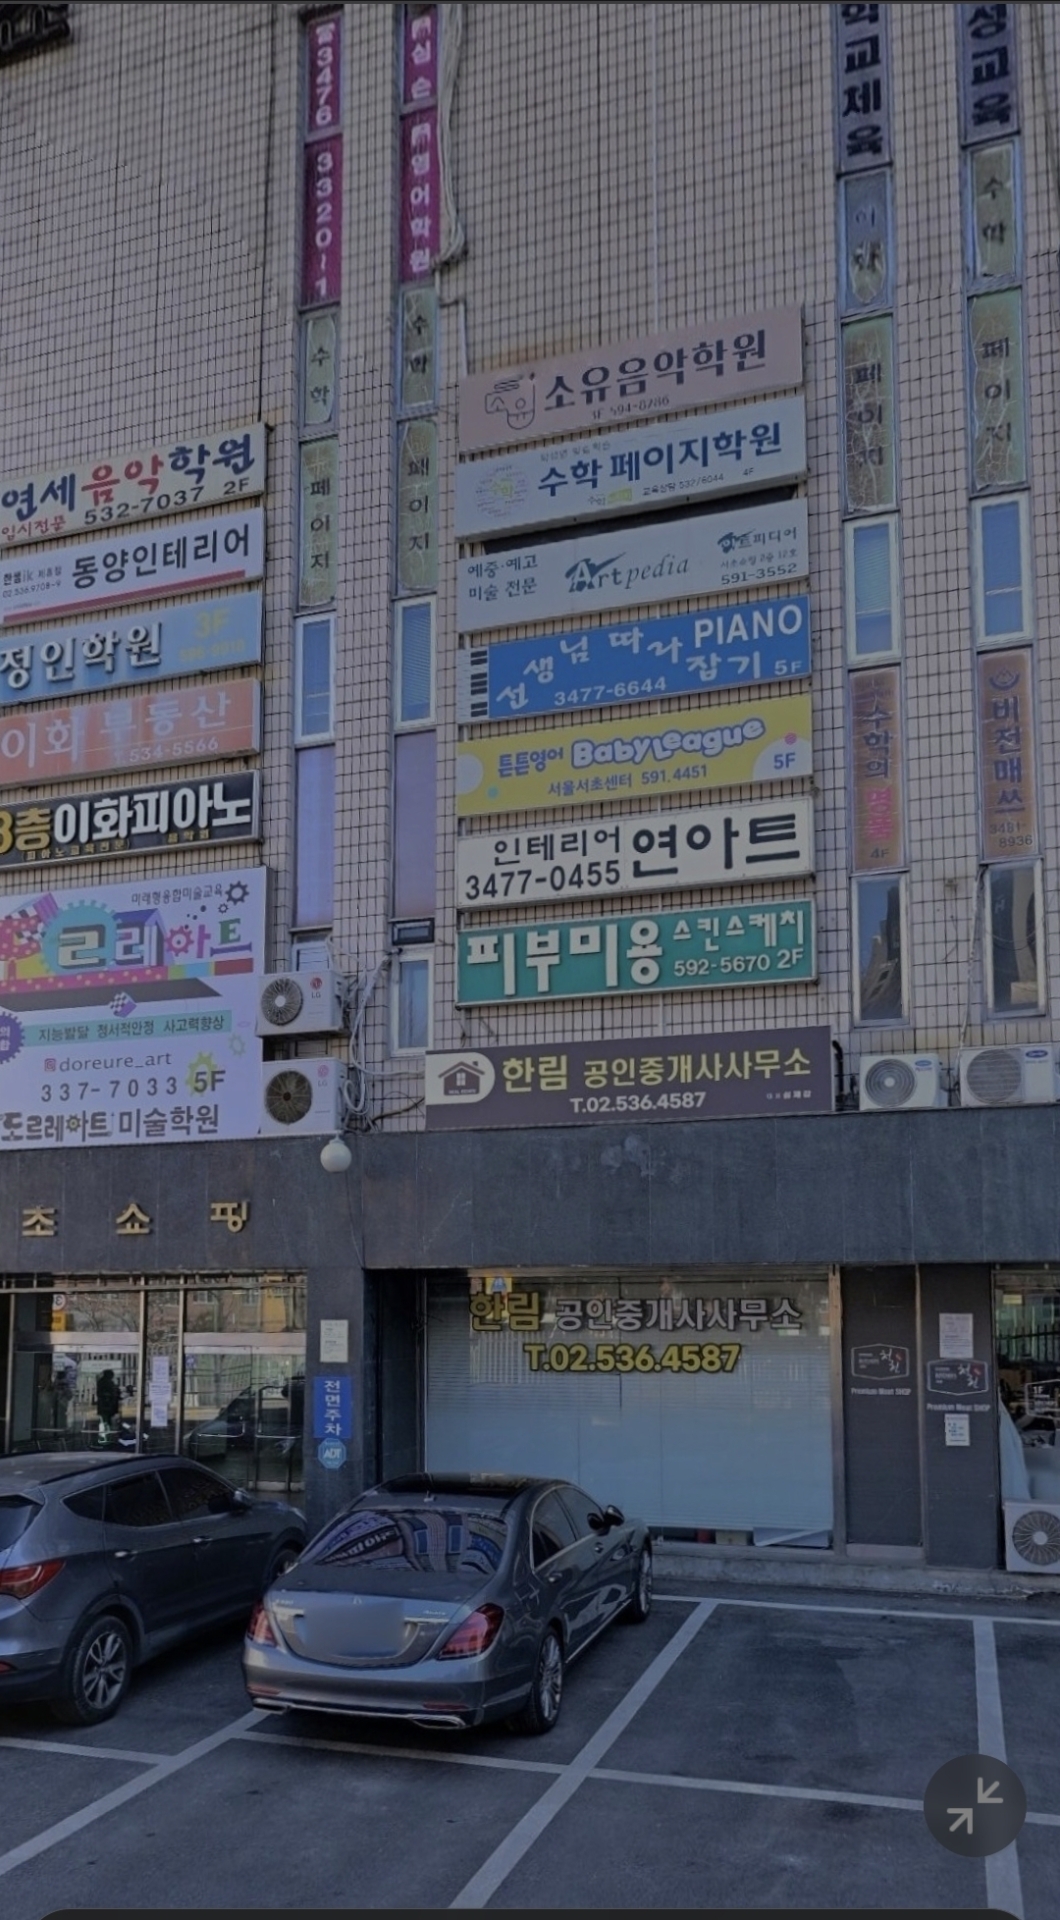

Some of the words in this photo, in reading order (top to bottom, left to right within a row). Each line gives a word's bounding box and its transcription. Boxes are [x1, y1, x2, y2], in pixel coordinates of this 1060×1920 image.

[315, 47, 333, 126] 3476
[310, 347, 331, 405] 수학
[544, 329, 766, 412] 소유음악학원
[982, 337, 1012, 443] 페이지
[537, 455, 603, 497] 수학
[610, 421, 782, 483] 페이지학원
[84, 485, 205, 526] 532-7037
[223, 476, 251, 496] 2F
[407, 457, 430, 552] 페이지
[1, 514, 67, 542] 입시전문
[309, 477, 331, 570] 페이지
[72, 523, 250, 590] 동양인테리어
[721, 561, 798, 586] 591-3552
[468, 582, 499, 602] 미술
[504, 576, 538, 599] 전문
[694, 603, 803, 649] PIANO
[0, 621, 163, 690] 정인학원
[496, 634, 590, 710] 선생님
[608, 627, 684, 664] 따라
[686, 651, 762, 682] 잡기
[773, 660, 802, 677] 5F
[554, 675, 668, 707] 3477-6644
[1, 709, 86, 769] 이화
[101, 690, 232, 743] 부동산
[498, 747, 564, 779] 튼튼영어
[773, 752, 796, 770] 5F
[548, 774, 633, 798] 서울서초센터
[641, 764, 708, 787] 591.4451
[53, 781, 251, 845] 이화피아노
[494, 826, 621, 867] 인테리어
[631, 812, 801, 880] 연아트
[870, 848, 890, 860] 4F
[465, 859, 621, 901] 3477-0455
[466, 918, 664, 997] 피부미용
[672, 909, 804, 952] 스킨스케치
[673, 957, 771, 978] 592-5670
[776, 948, 804, 970] 2F
[38, 1024, 89, 1042] 지능발달
[97, 1019, 155, 1039] 정서적안정
[163, 1014, 225, 1034] 사고력향상
[59, 1051, 173, 1073] doreure_art
[194, 1069, 226, 1094] 5F
[502, 1053, 568, 1094] 한림
[583, 1047, 812, 1090] 공인중개사사무소
[118, 1103, 219, 1139] 미술학원
[569, 1091, 707, 1115] T.02.536.4587
[468, 1290, 542, 1332] 한림
[554, 1298, 803, 1333] 공인중개사사무소
[523, 1343, 743, 1373] T.02.536.4587
[324, 1380, 342, 1437] 전면주차
[895, 1386, 912, 1396] SHOP
[974, 1402, 991, 1412] SHOP
[323, 1447, 342, 1459] ADT
